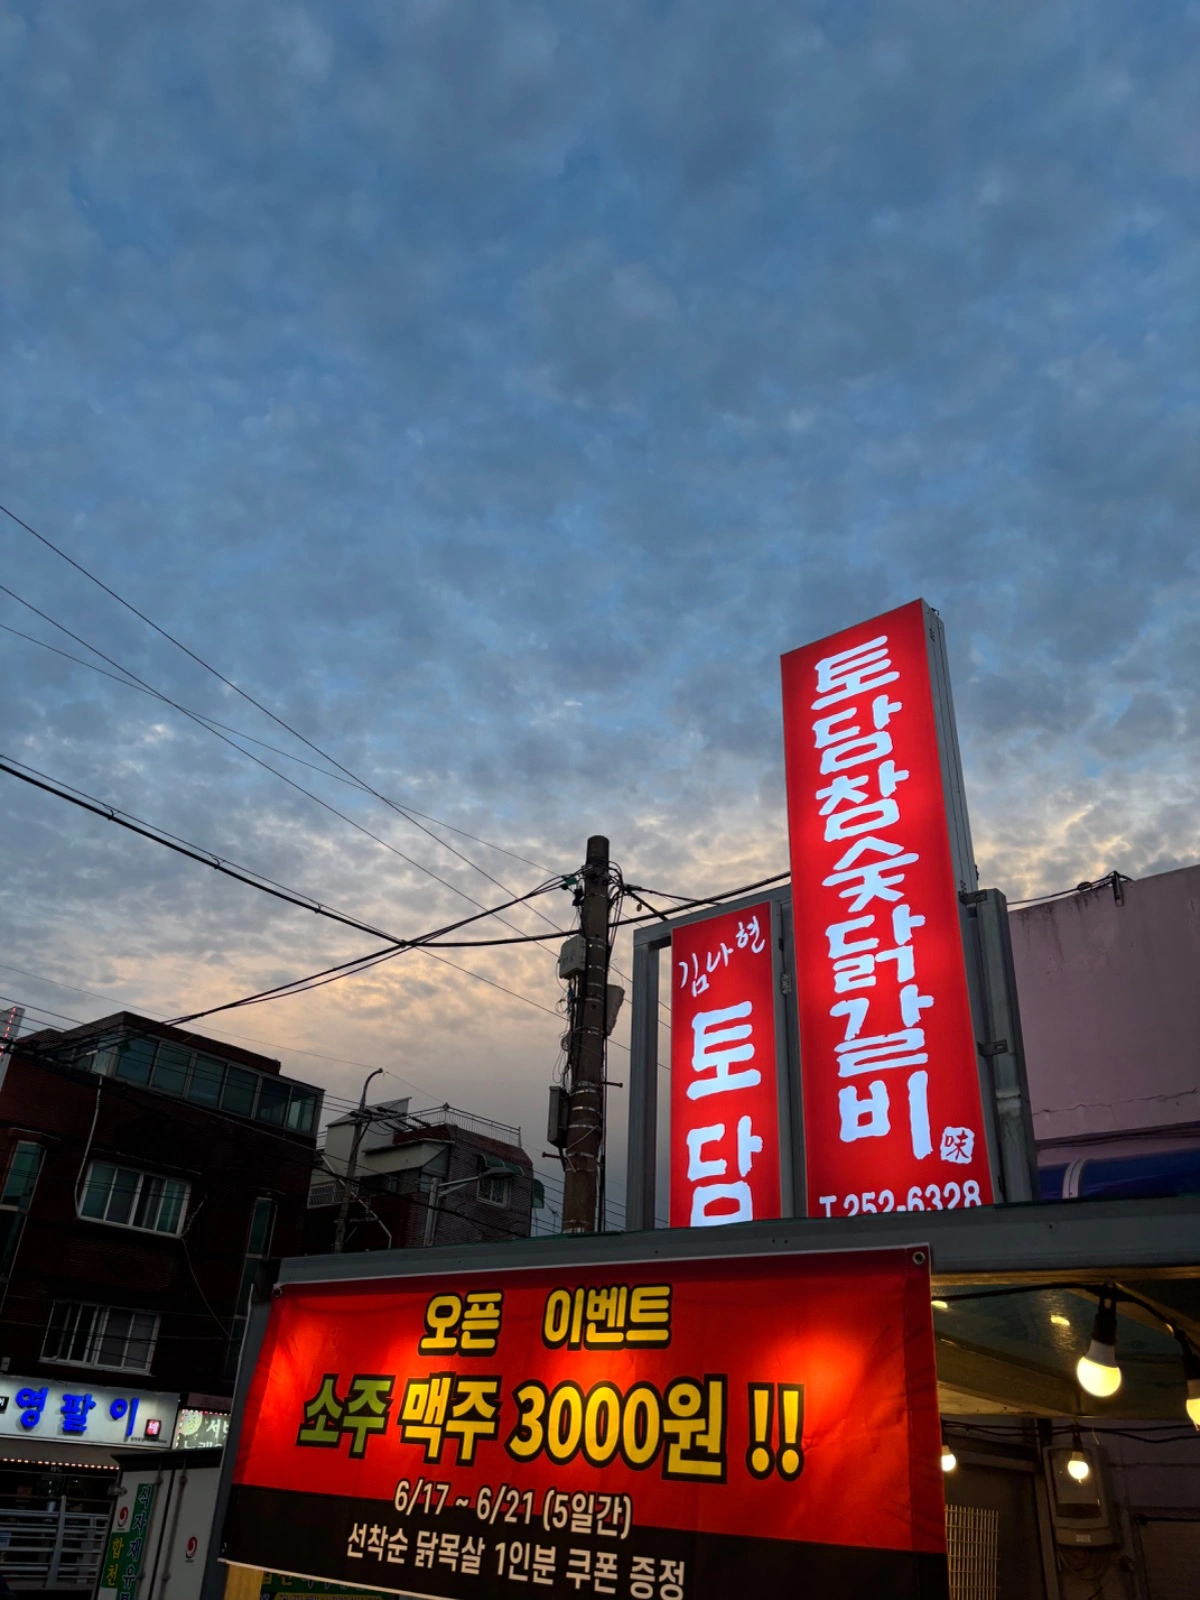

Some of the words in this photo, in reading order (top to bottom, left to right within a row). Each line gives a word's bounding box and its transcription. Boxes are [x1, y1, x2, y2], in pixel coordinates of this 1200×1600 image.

[677, 914, 767, 998] 김나현
[685, 999, 763, 1229] 토담
[942, 1128, 974, 1163] 味
[419, 1291, 503, 1351] 오픈
[543, 1284, 671, 1344] 이벤트
[14, 1385, 142, 1437] 영팔이
[299, 1377, 393, 1454] 소주
[401, 1375, 499, 1461] 맥주
[508, 1379, 724, 1478] 3000원
[394, 1479, 450, 1516] 6/17
[455, 1497, 469, 1507] ~
[476, 1485, 533, 1525] 6/21
[543, 1488, 632, 1540] (5일간)
[104, 1536, 125, 1587] 합천
[346, 1522, 408, 1565] 선착순
[414, 1530, 486, 1575] 닭목살
[494, 1541, 557, 1585] 1인분
[566, 1548, 618, 1595] 쿠폰
[630, 1555, 686, 1600] 증정
